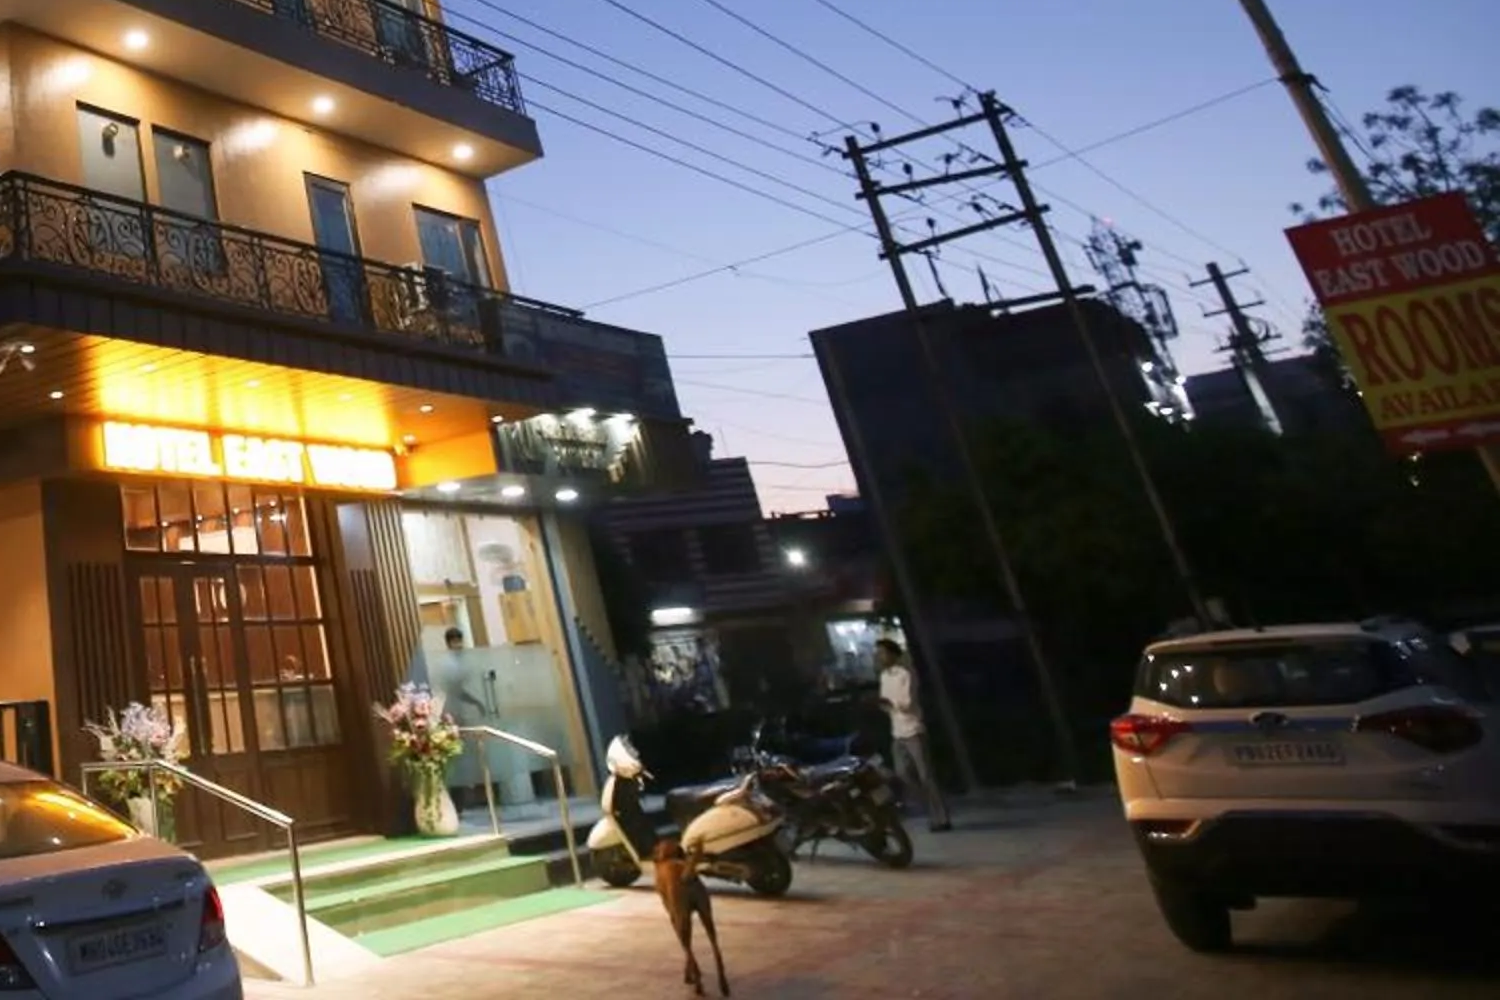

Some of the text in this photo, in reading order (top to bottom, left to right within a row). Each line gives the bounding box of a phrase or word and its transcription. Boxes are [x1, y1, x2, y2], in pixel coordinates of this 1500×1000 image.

[1331, 213, 1432, 257] HOTEL
[1314, 240, 1485, 297] EAST WOOD
